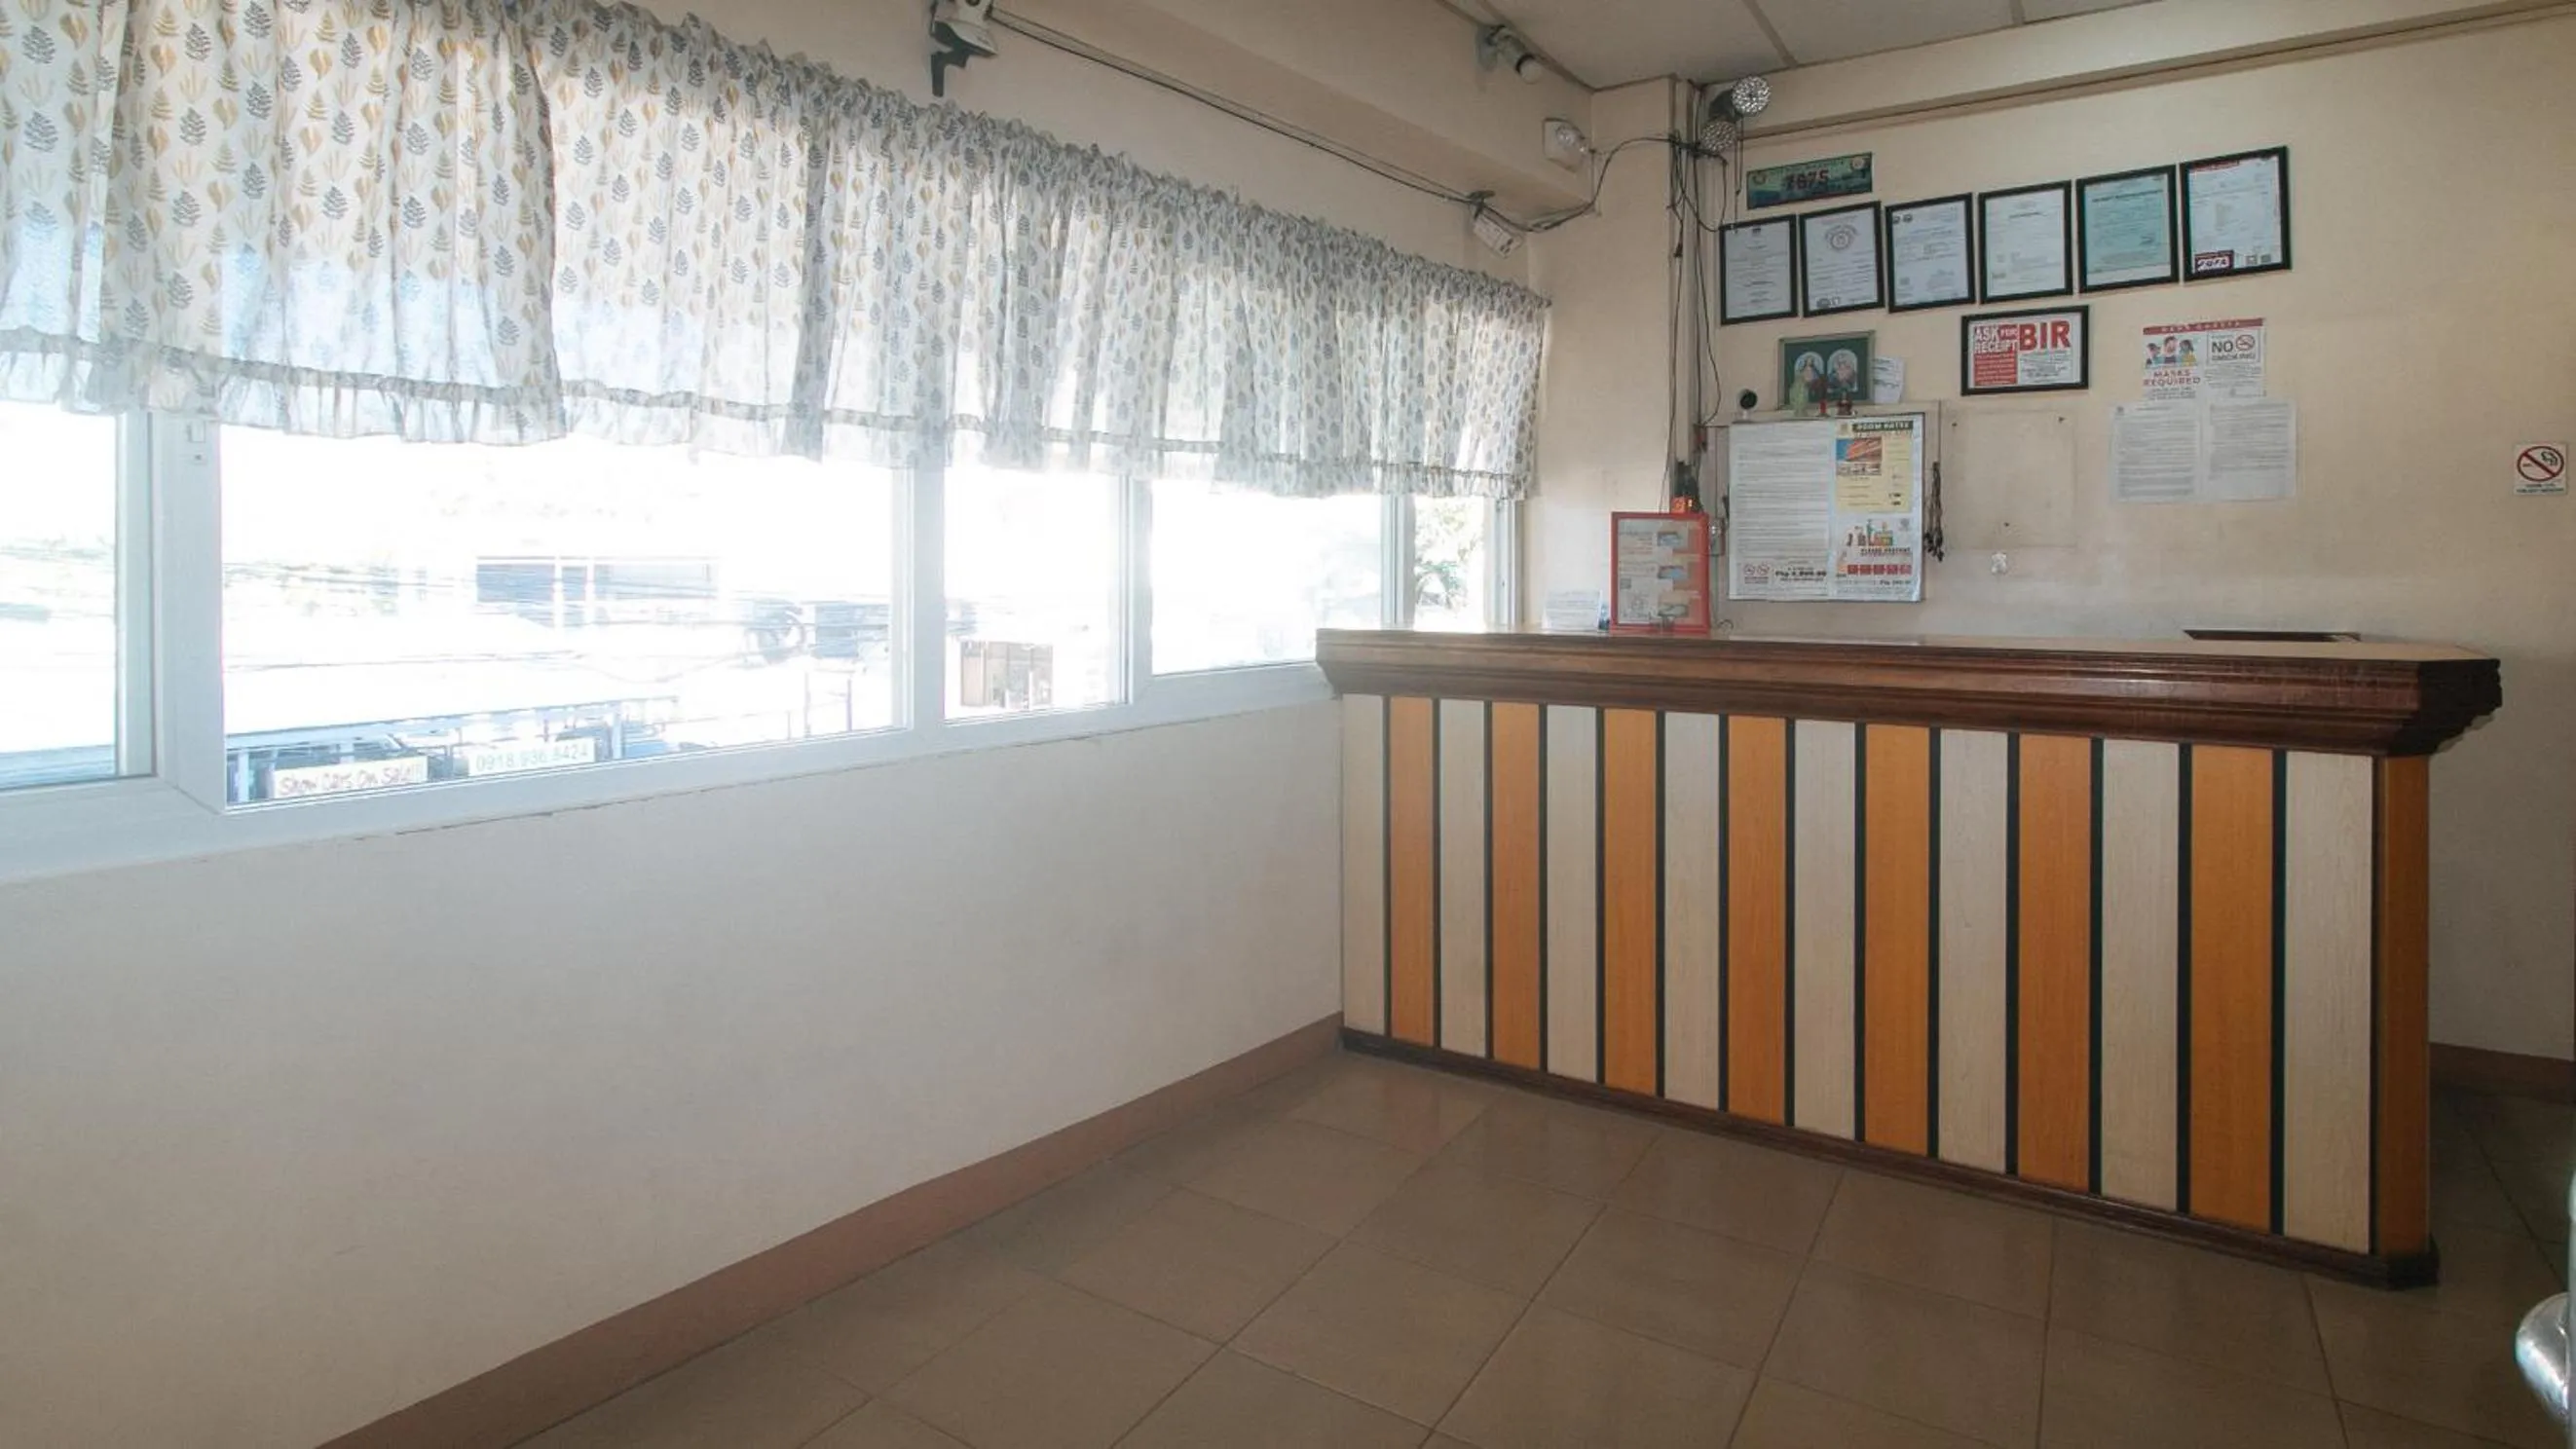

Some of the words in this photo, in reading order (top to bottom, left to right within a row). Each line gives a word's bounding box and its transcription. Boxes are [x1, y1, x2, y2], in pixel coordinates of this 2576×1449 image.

[1974, 325, 1999, 342] ASK
[2019, 320, 2071, 351] BIR
[1974, 340, 2017, 353] RECEIPT
[2211, 340, 2234, 353] NO
[2153, 369, 2191, 378] MASKS
[2143, 377, 2201, 387] REQUIRED
[356, 769, 379, 786] On
